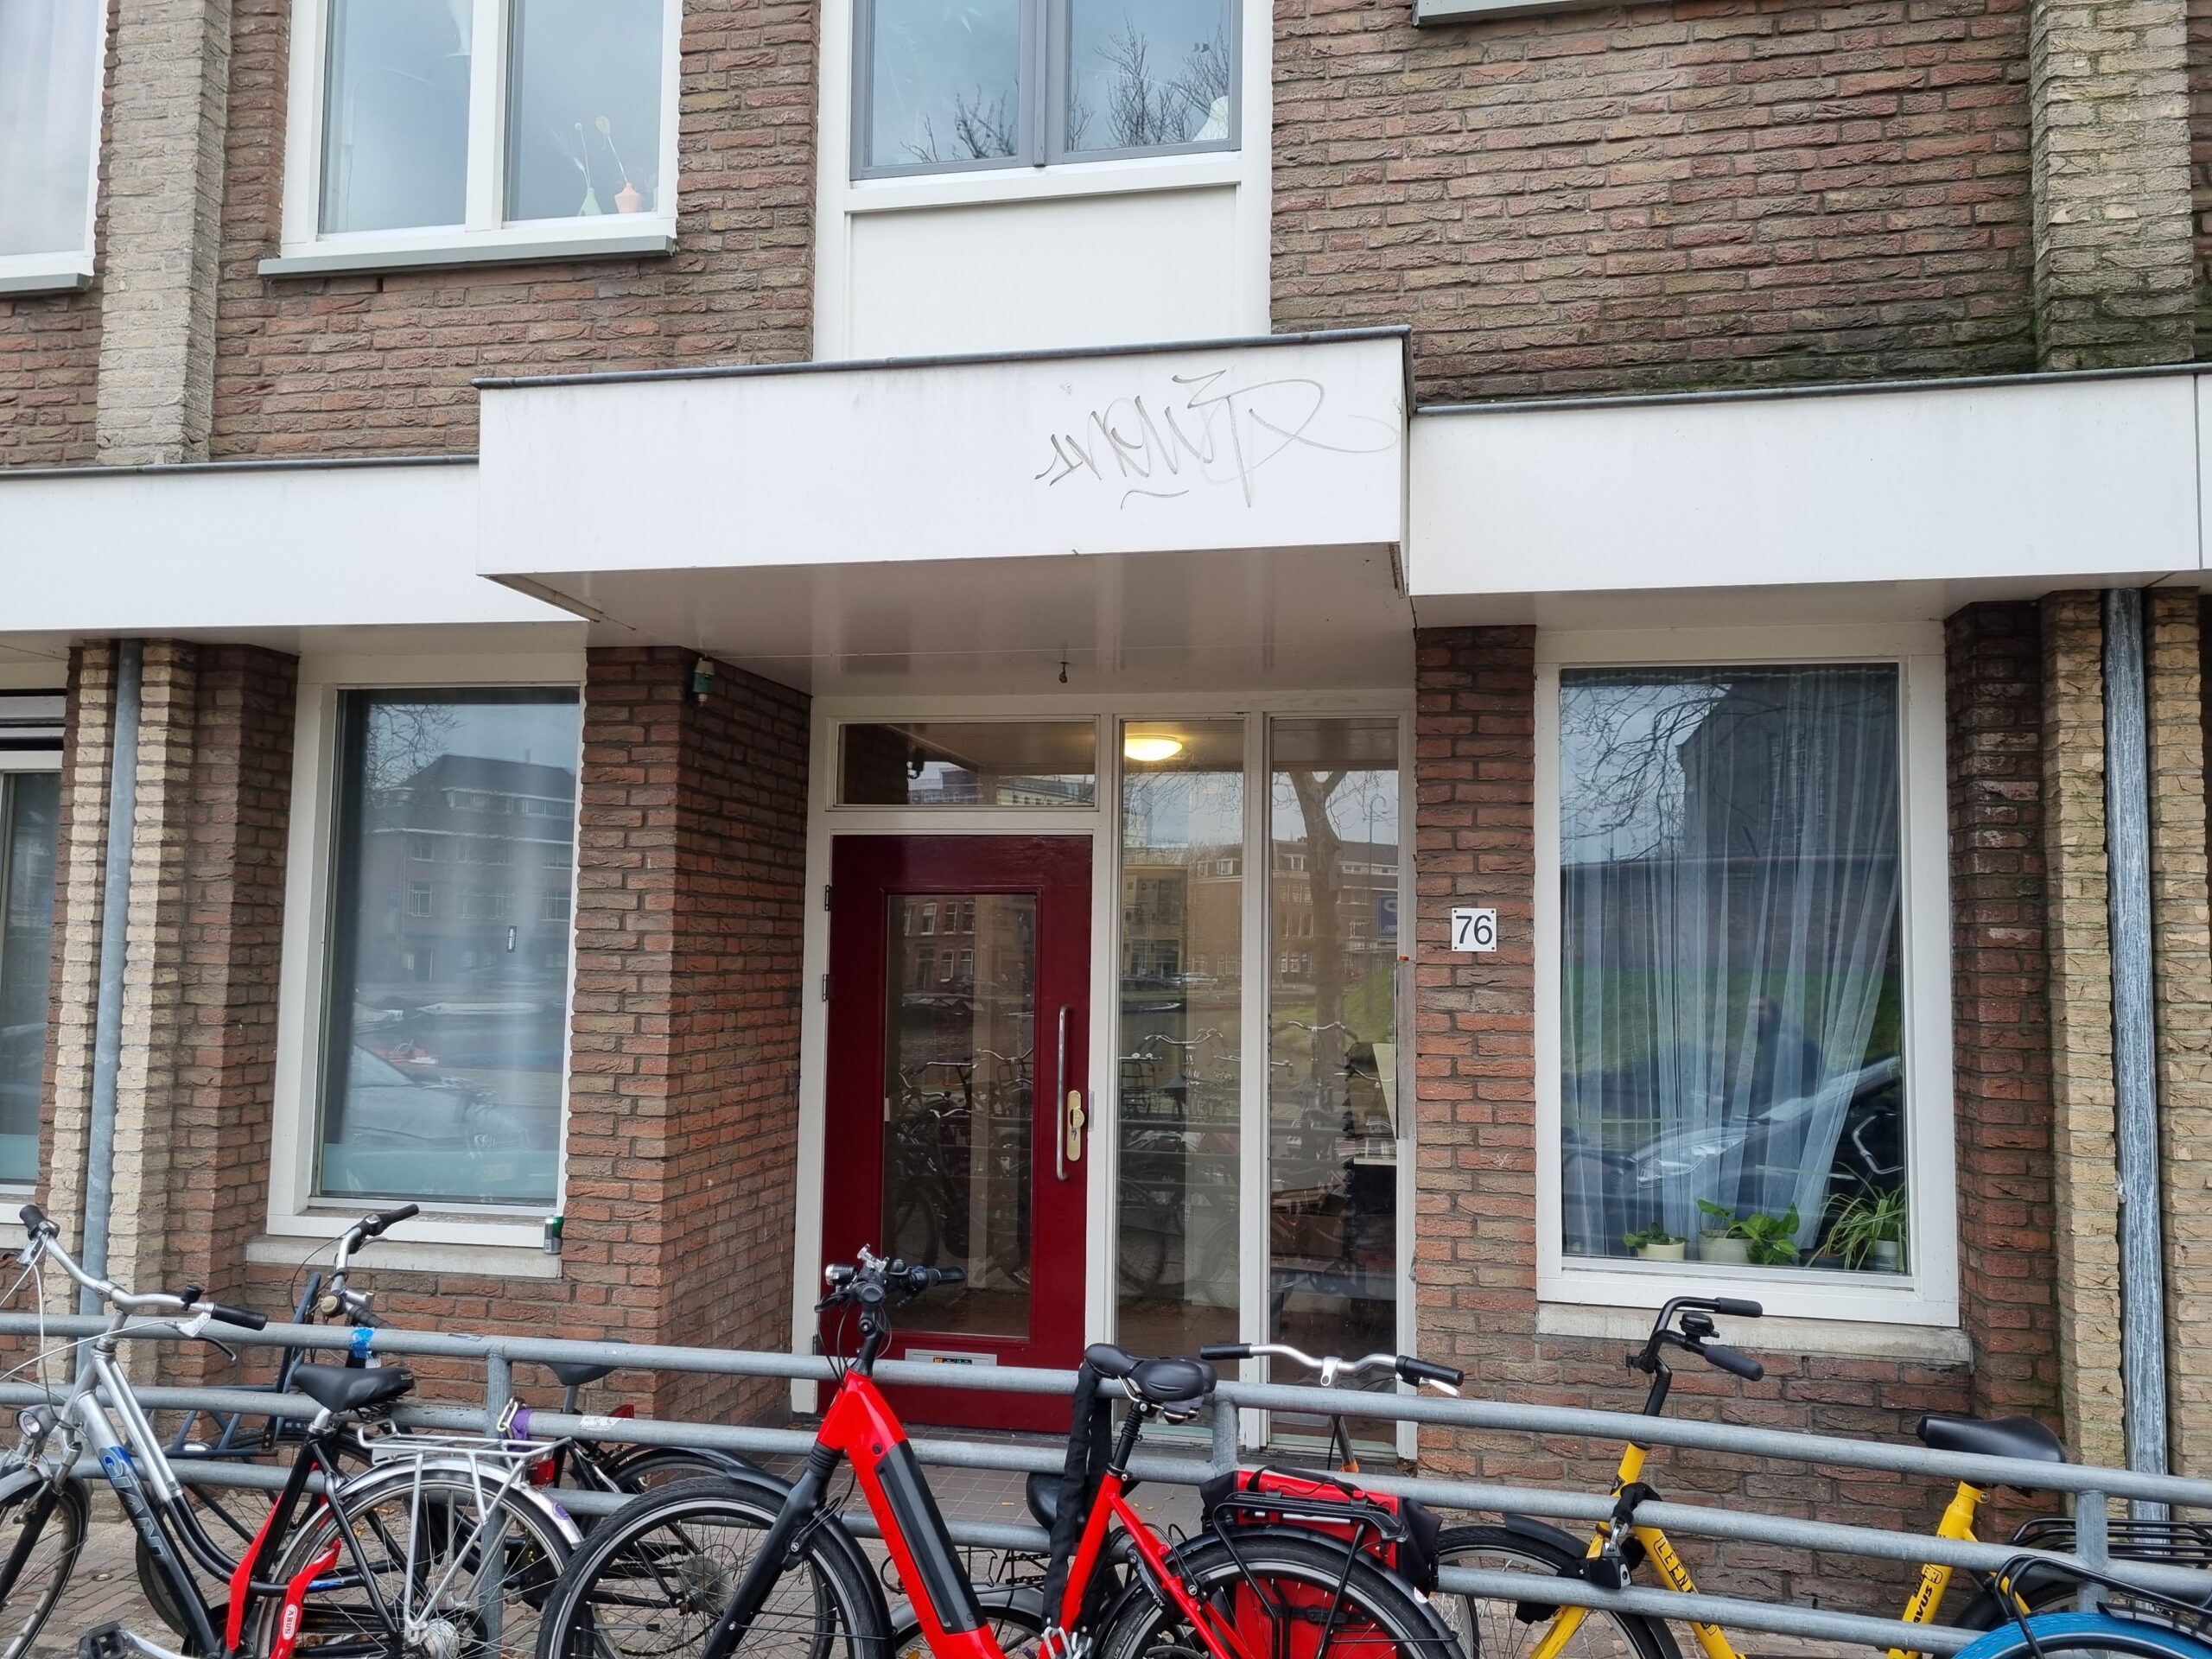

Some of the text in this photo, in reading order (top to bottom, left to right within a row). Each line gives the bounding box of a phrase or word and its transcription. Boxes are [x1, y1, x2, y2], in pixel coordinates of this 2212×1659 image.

[1456, 914, 1493, 945] 76
[98, 1447, 169, 1559] GIANT
[867, 1484, 931, 1624] GAZELLE
[284, 1609, 295, 1636] ABUS
